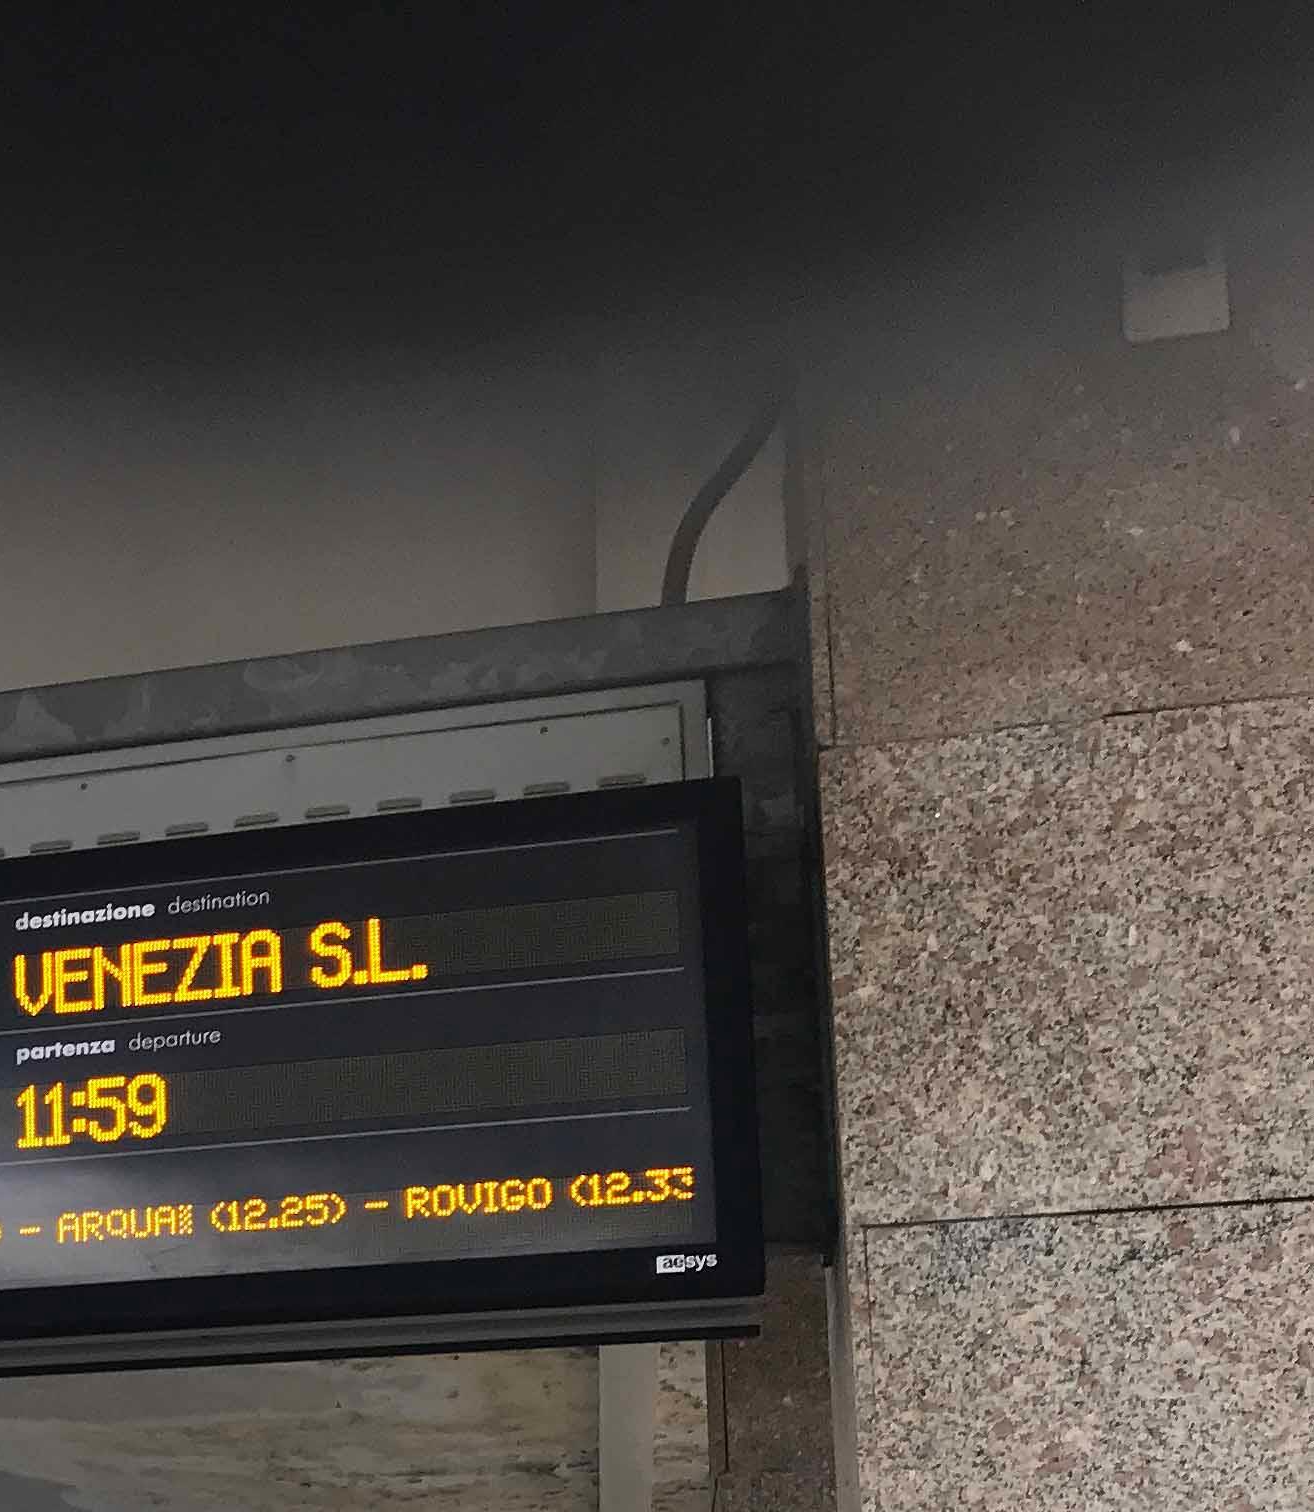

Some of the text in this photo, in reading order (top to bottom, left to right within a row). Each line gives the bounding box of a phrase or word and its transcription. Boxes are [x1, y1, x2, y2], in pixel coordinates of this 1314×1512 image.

[15, 889, 270, 931] destinazione destination
[14, 918, 429, 1017] VENEZIA S.L.
[16, 1027, 221, 1065] partenza departure
[15, 1072, 167, 1149] 11:59
[210, 1193, 347, 1233] (12.25)
[404, 1177, 553, 1219] ROVIGO
[659, 1252, 718, 1272] aesys
